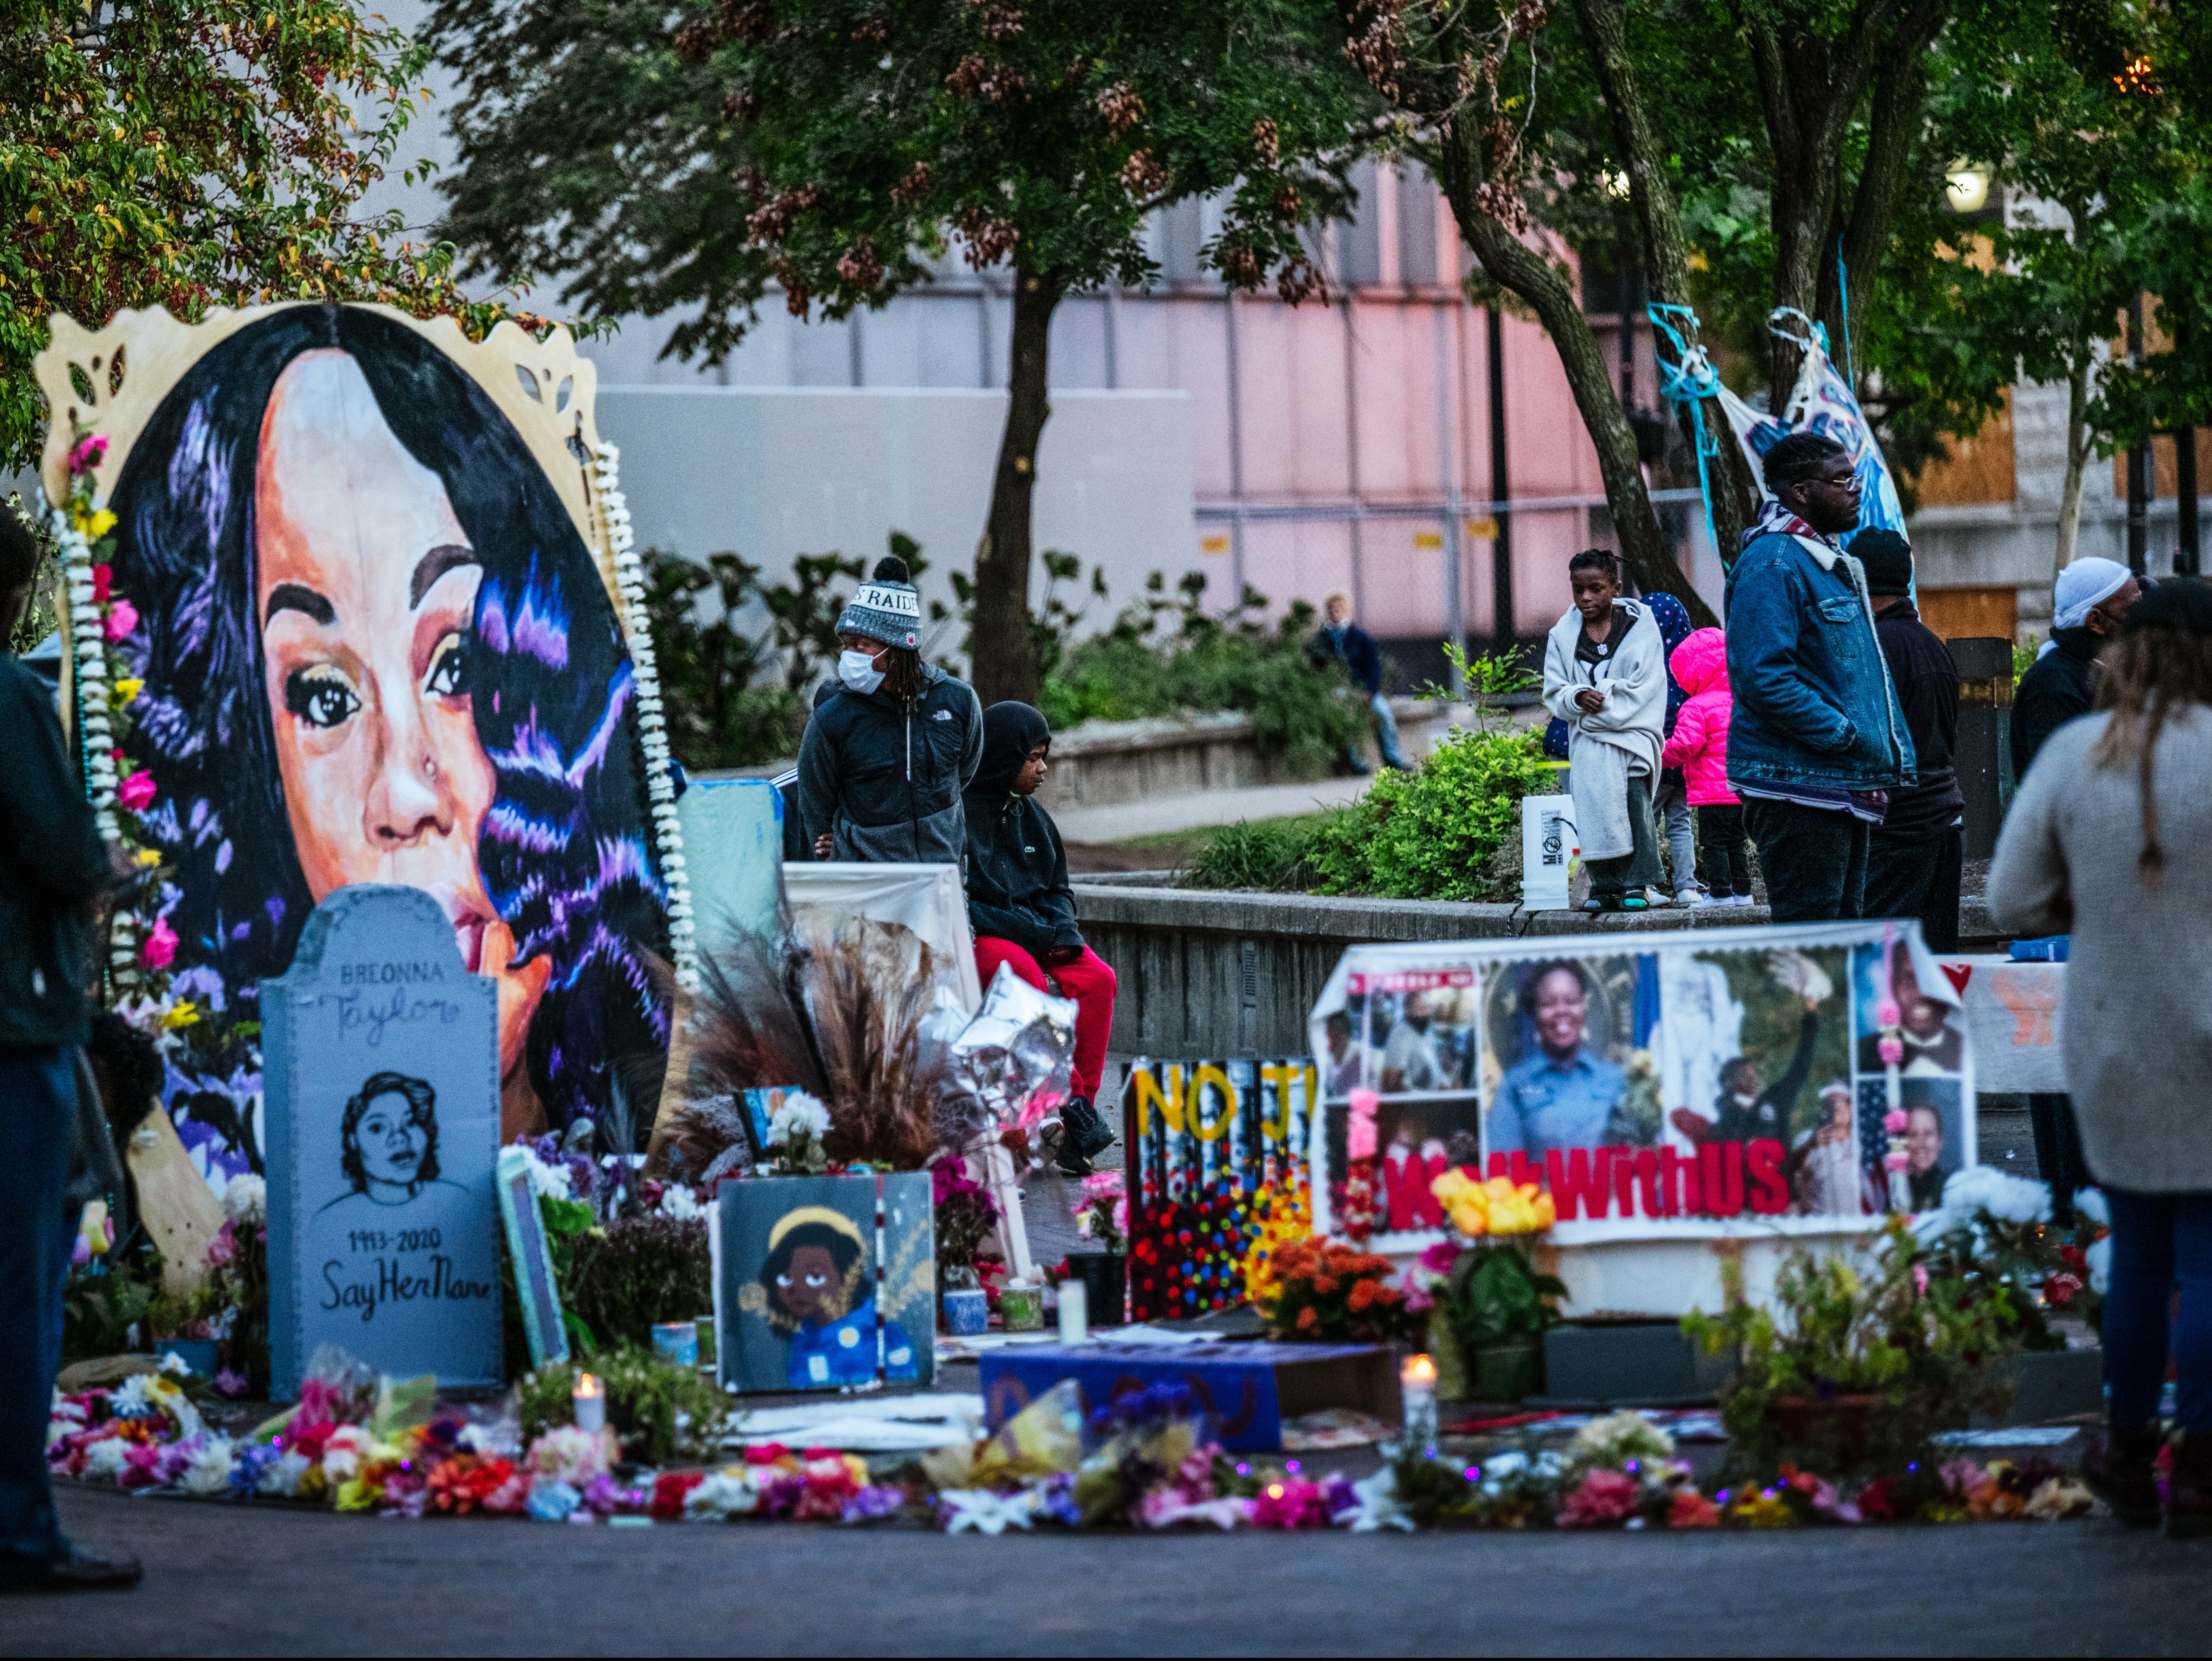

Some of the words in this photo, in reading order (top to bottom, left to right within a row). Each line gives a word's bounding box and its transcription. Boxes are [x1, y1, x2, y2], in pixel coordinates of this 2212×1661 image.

[341, 962, 443, 984] BREONNA
[317, 986, 460, 1048] Taylor
[1135, 1065, 1237, 1141] NO
[1260, 1066, 1318, 1141] J
[348, 1228, 442, 1252] 1993-2020
